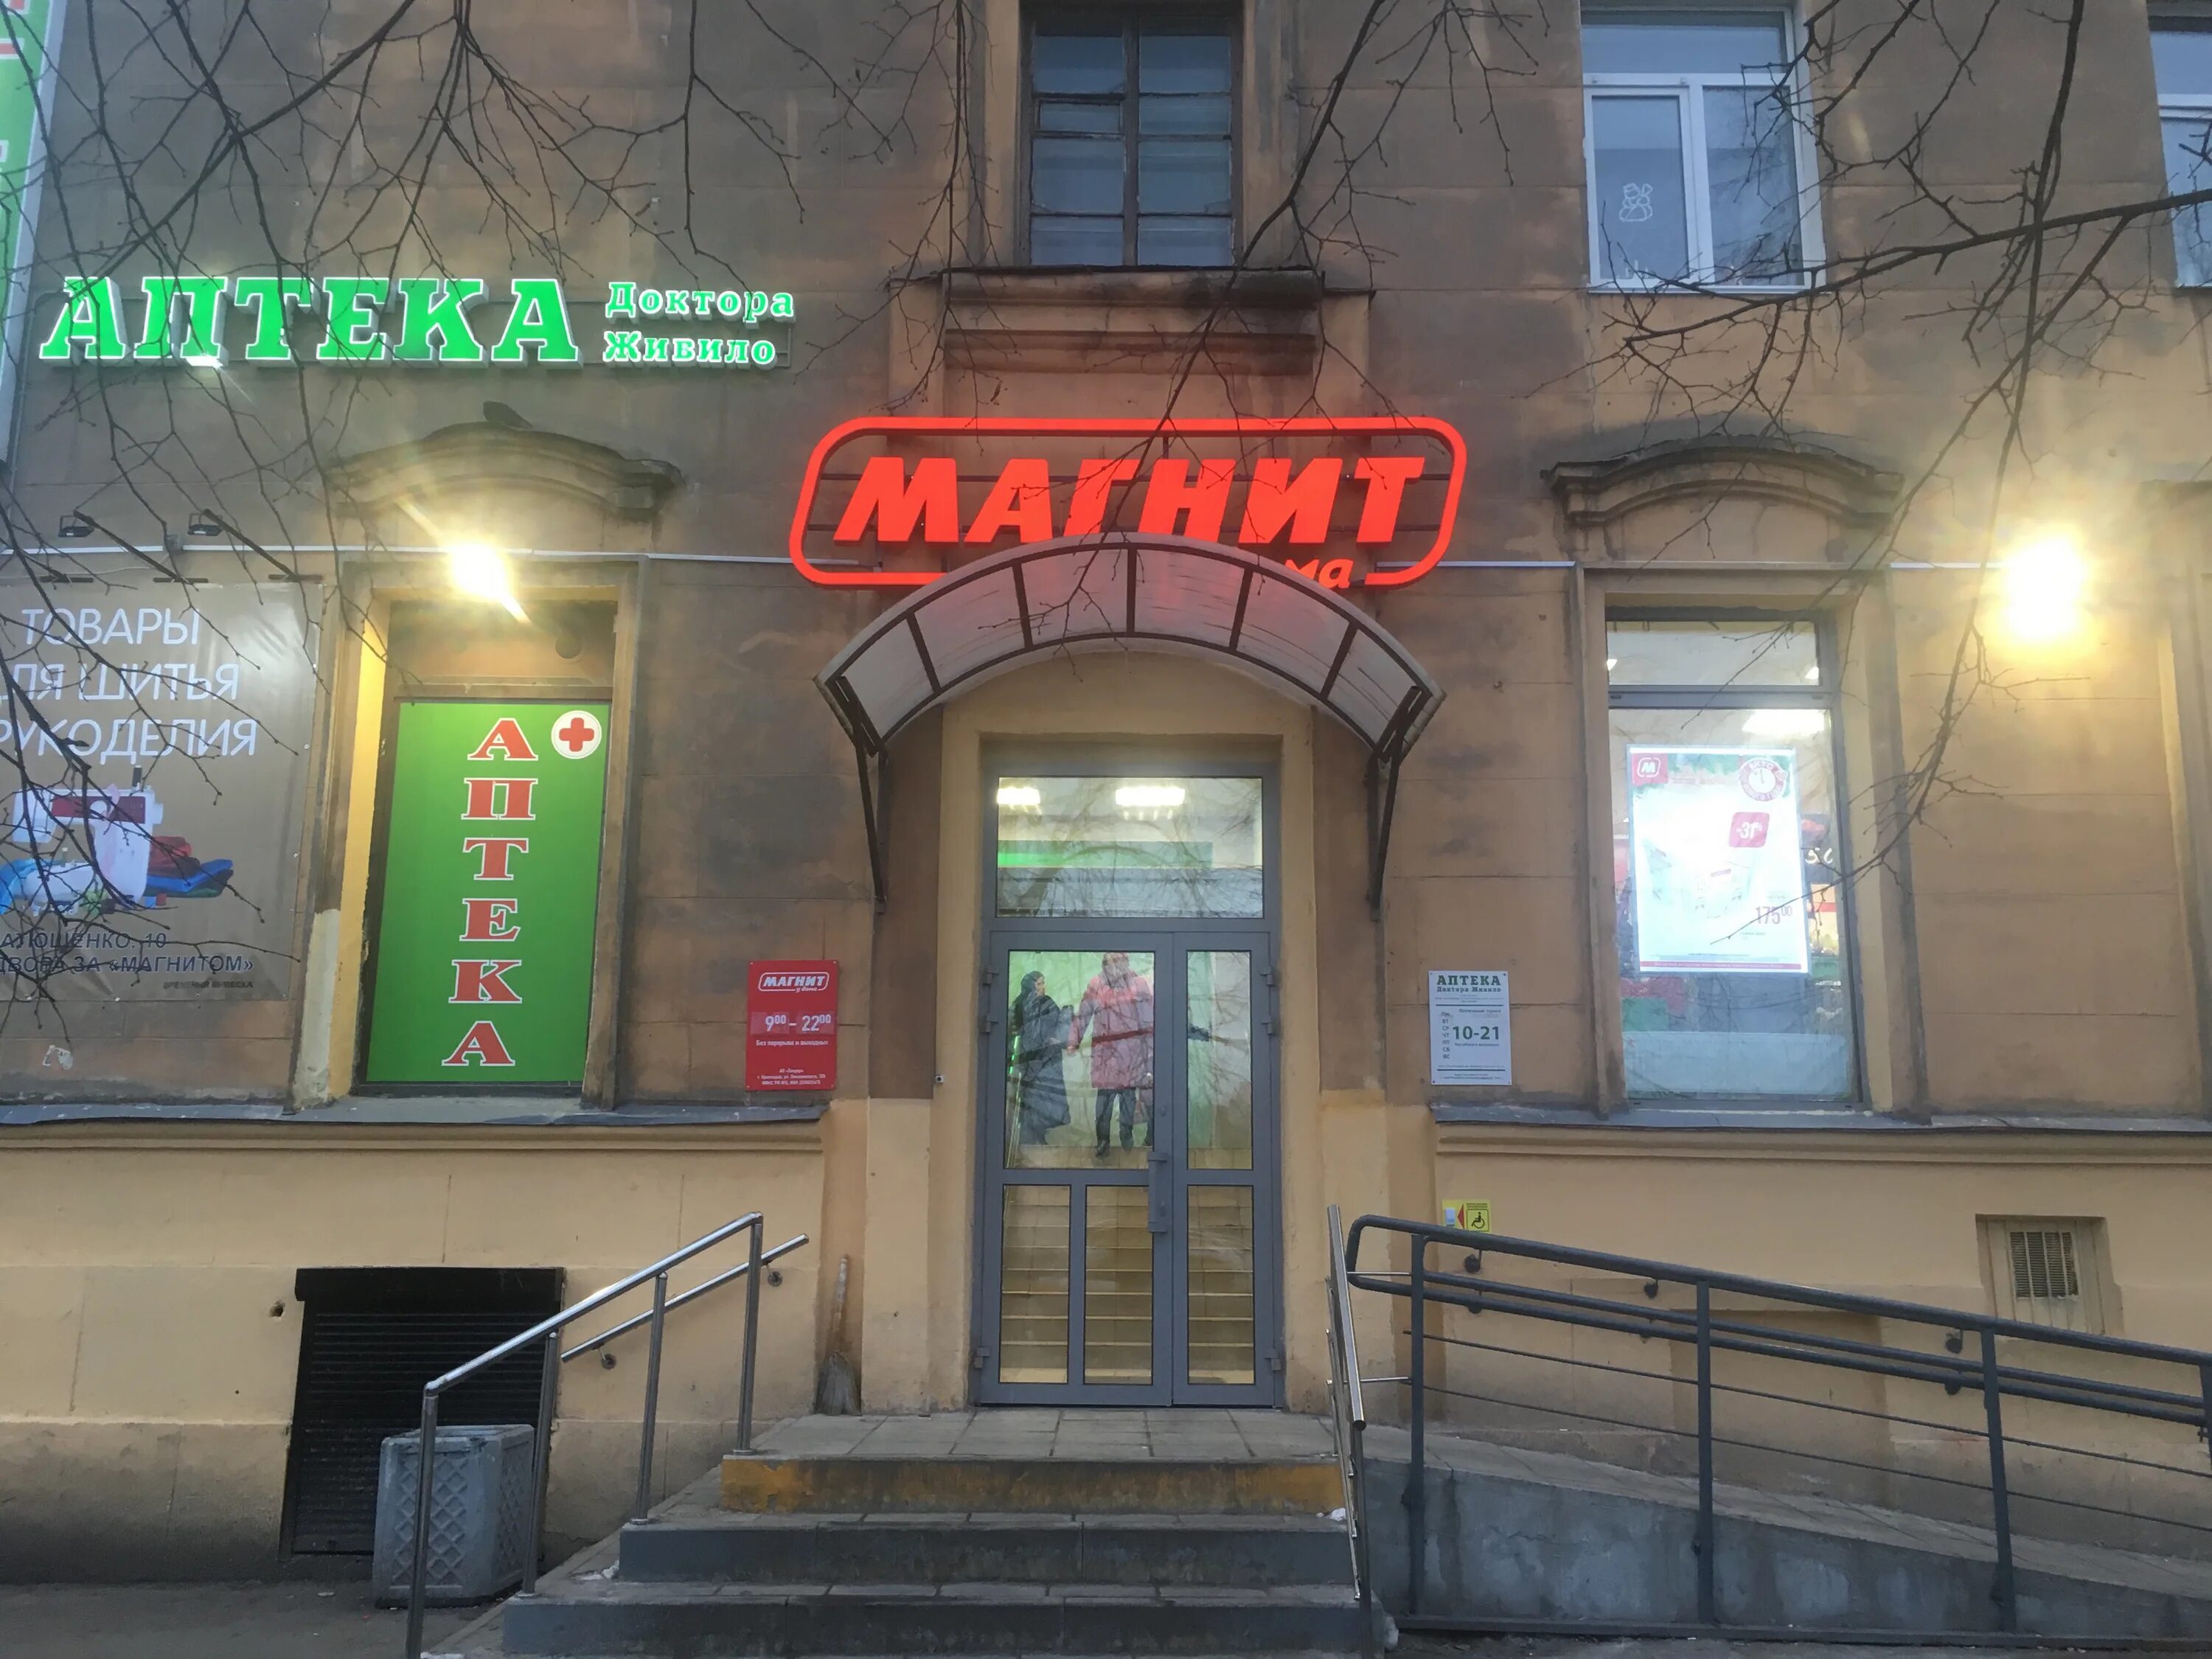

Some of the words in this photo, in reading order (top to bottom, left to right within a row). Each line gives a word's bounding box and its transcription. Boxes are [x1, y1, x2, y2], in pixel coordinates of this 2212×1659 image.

[40, 276, 583, 362] АПТЕКА
[605, 282, 794, 323] Доктора
[603, 330, 776, 364] Живило
[833, 456, 1425, 544] МАГНИТ
[1284, 558, 1354, 588] ма
[21, 608, 200, 644] ТОВАРЫ
[0, 663, 64, 700] ЛЯ
[78, 663, 240, 700] ШИТЬЯ
[442, 717, 539, 1067] АПТЕКА
[145, 932, 167, 949] 10
[74, 956, 100, 973] ЗА
[763, 975, 825, 987] МАГНИТ
[1436, 975, 1501, 986] АПТЕКА
[1453, 1026, 1500, 1040] 10-21
